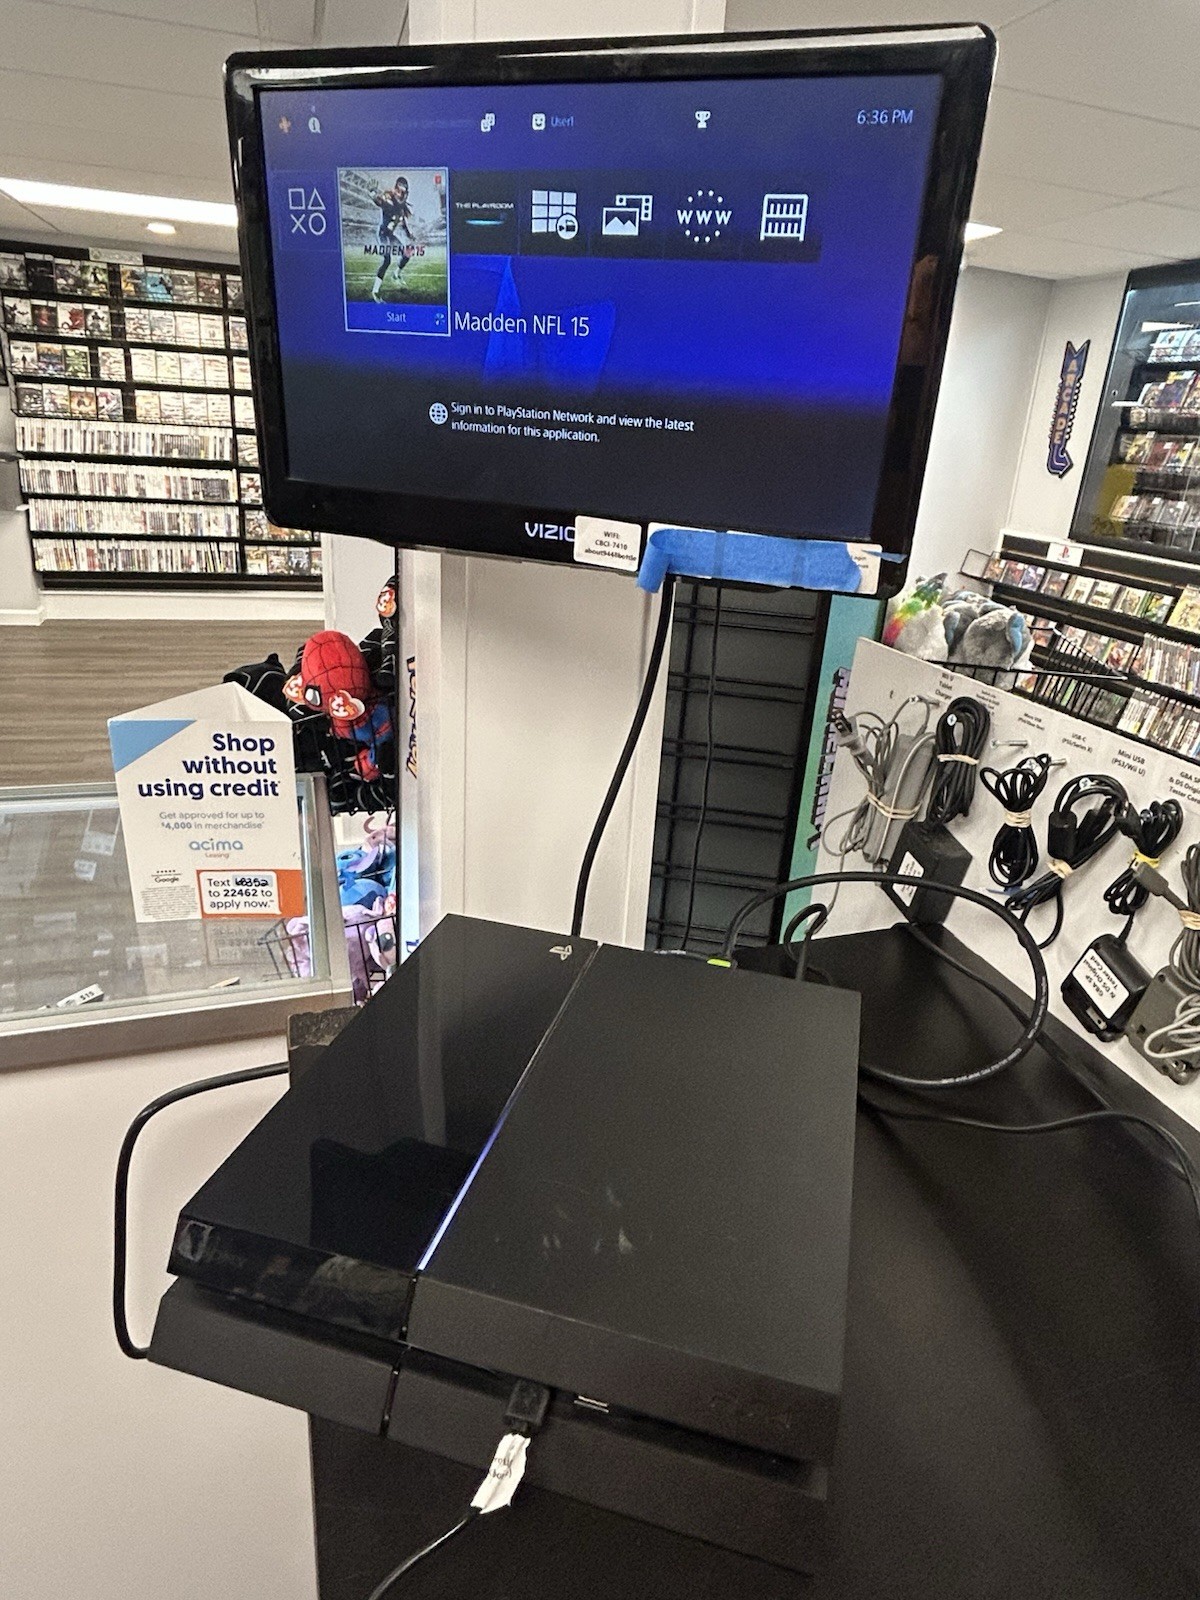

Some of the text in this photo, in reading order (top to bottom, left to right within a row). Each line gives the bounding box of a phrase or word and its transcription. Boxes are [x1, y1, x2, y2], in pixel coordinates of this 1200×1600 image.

[857, 109, 914, 125] 6:36 PM
[386, 310, 406, 323] Start
[454, 311, 589, 337] Madden NFL 15
[1053, 359, 1077, 443] ARCADE
[451, 402, 695, 431] Sign in to PlayStation Network and view the latest
[451, 420, 600, 443] information for this application.
[212, 733, 275, 756] Shop
[181, 756, 277, 774] without
[1112, 757, 1137, 773] (PS3/Wii
[1118, 749, 1145, 765] Mini USB
[138, 778, 204, 800] using
[159, 811, 265, 821] Get approved for up to
[195, 821, 203, 829] in
[188, 837, 244, 851] acima
[207, 878, 231, 887] Text
[208, 888, 273, 898] to 22462 to
[209, 901, 242, 910] apply
